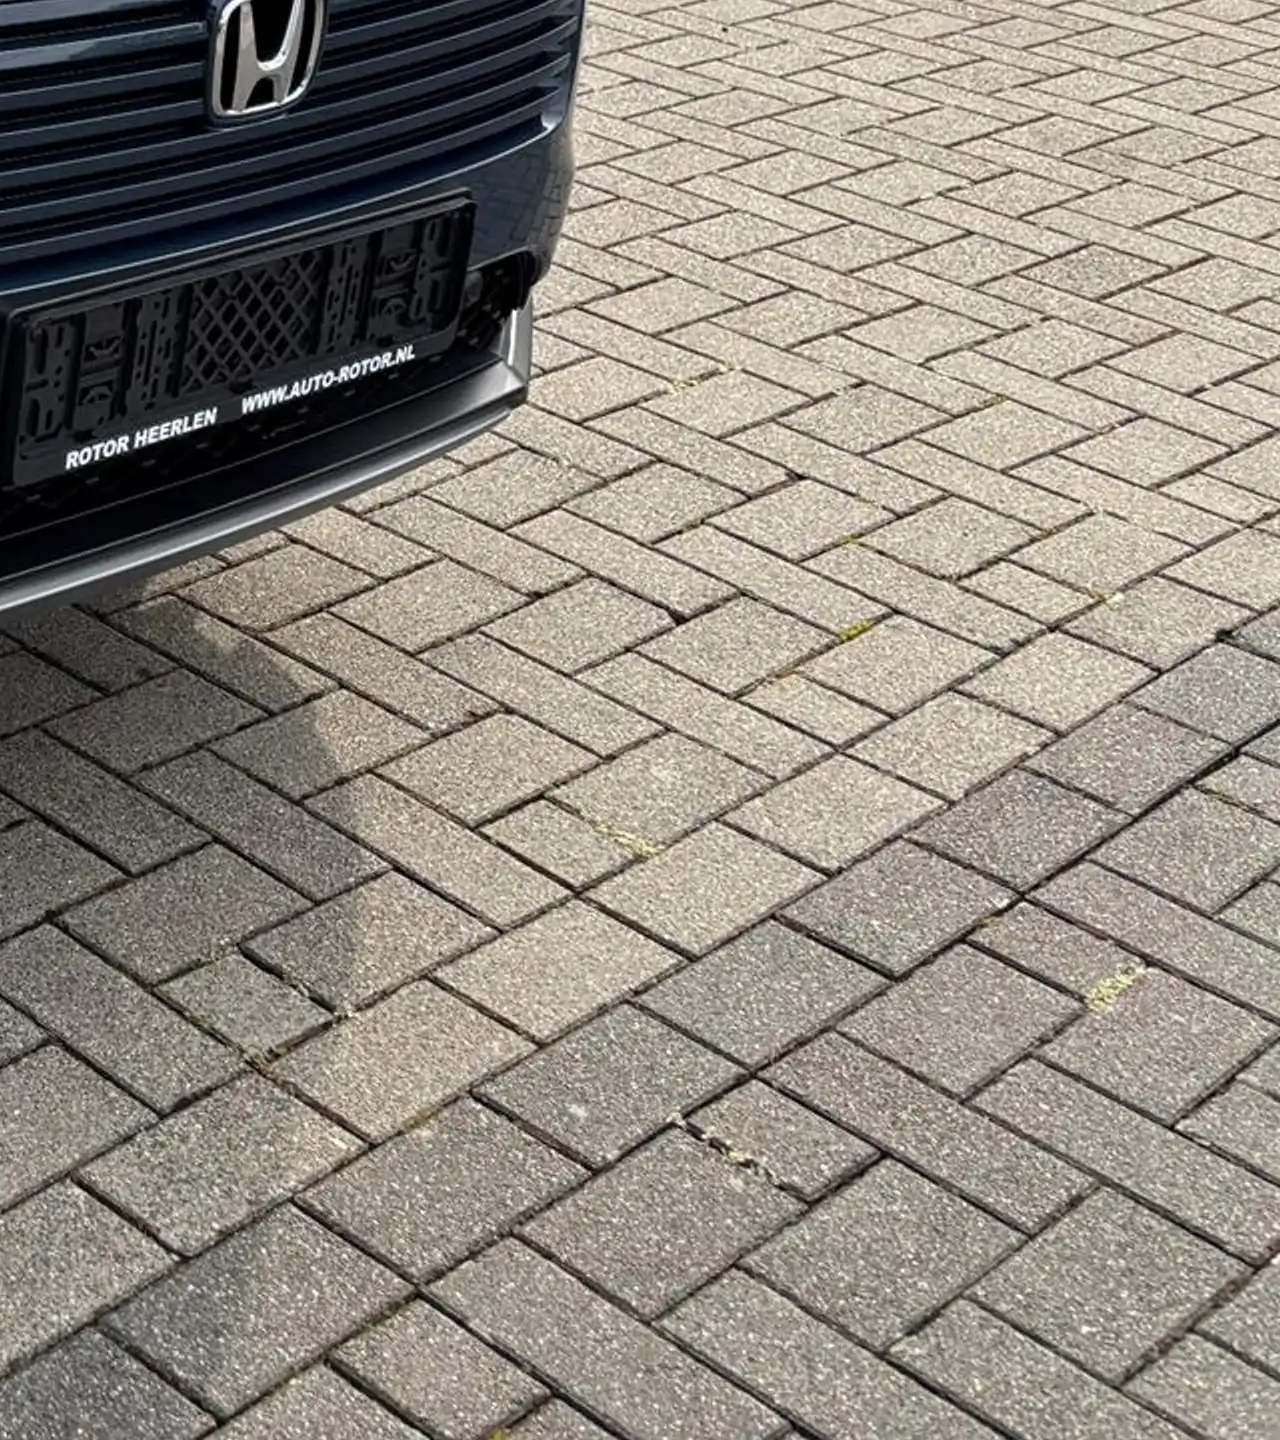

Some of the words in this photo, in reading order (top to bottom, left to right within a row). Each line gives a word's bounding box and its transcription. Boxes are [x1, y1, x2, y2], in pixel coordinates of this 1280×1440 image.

[65, 435, 130, 471] ROTOR
[133, 406, 218, 449] HEERLEN
[241, 344, 416, 415] WWW.AUTO-ROTOR.NL
